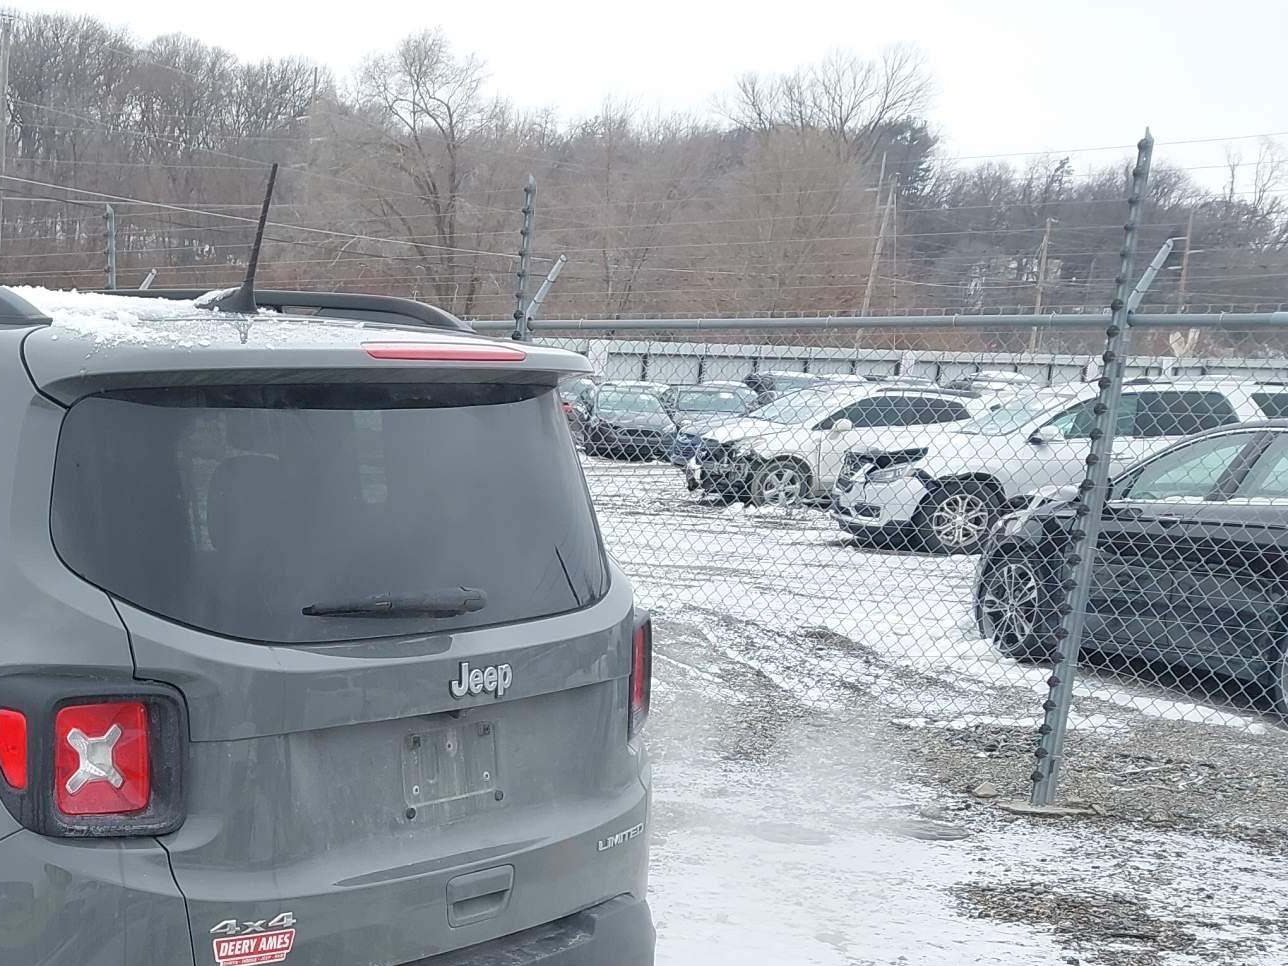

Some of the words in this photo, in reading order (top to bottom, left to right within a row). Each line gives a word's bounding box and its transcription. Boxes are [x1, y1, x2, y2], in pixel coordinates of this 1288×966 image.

[450, 661, 513, 698] Jeep
[598, 822, 644, 851] LIMITED
[219, 938, 257, 957] DEERY
[258, 934, 291, 952] AMES
